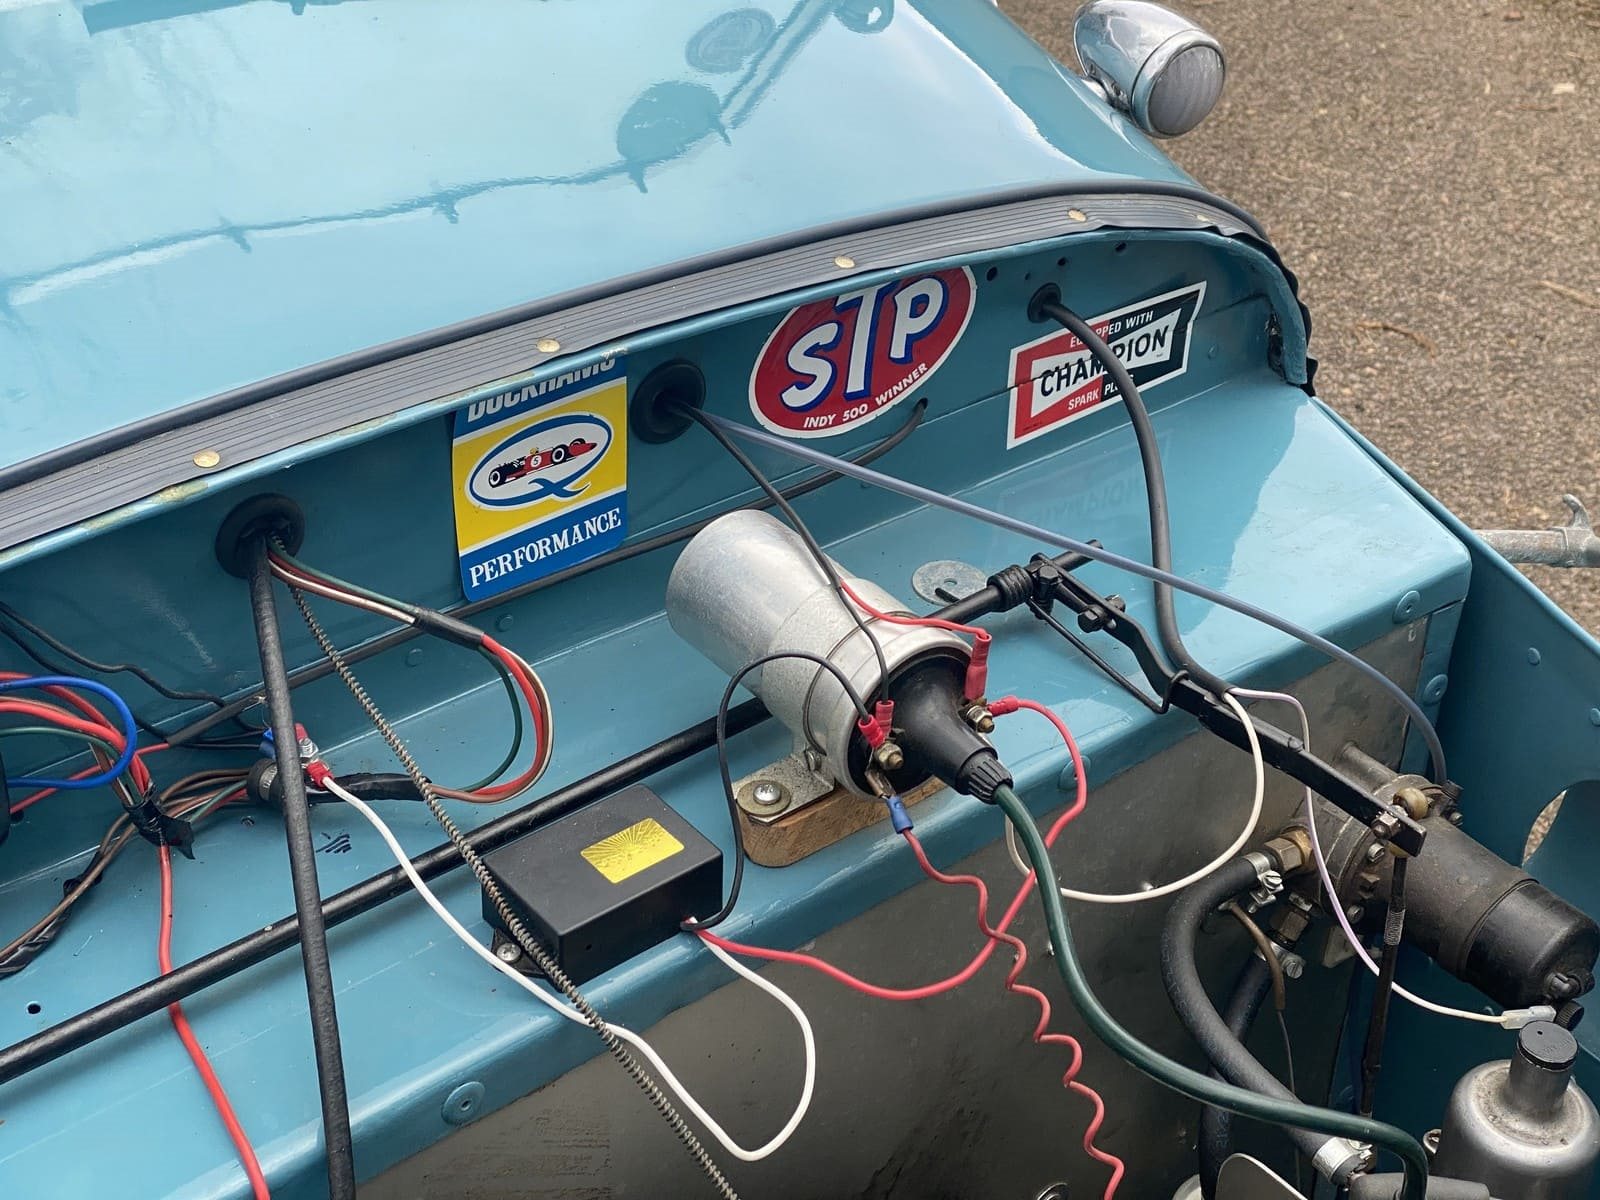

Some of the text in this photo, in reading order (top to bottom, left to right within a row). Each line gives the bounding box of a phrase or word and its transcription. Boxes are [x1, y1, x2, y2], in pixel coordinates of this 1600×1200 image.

[781, 277, 947, 411] STP
[1126, 310, 1154, 329] WITH
[803, 362, 928, 428] INDY 500 WINNER
[1068, 387, 1100, 411] SPARK
[469, 508, 622, 588] PERFORMANCE
